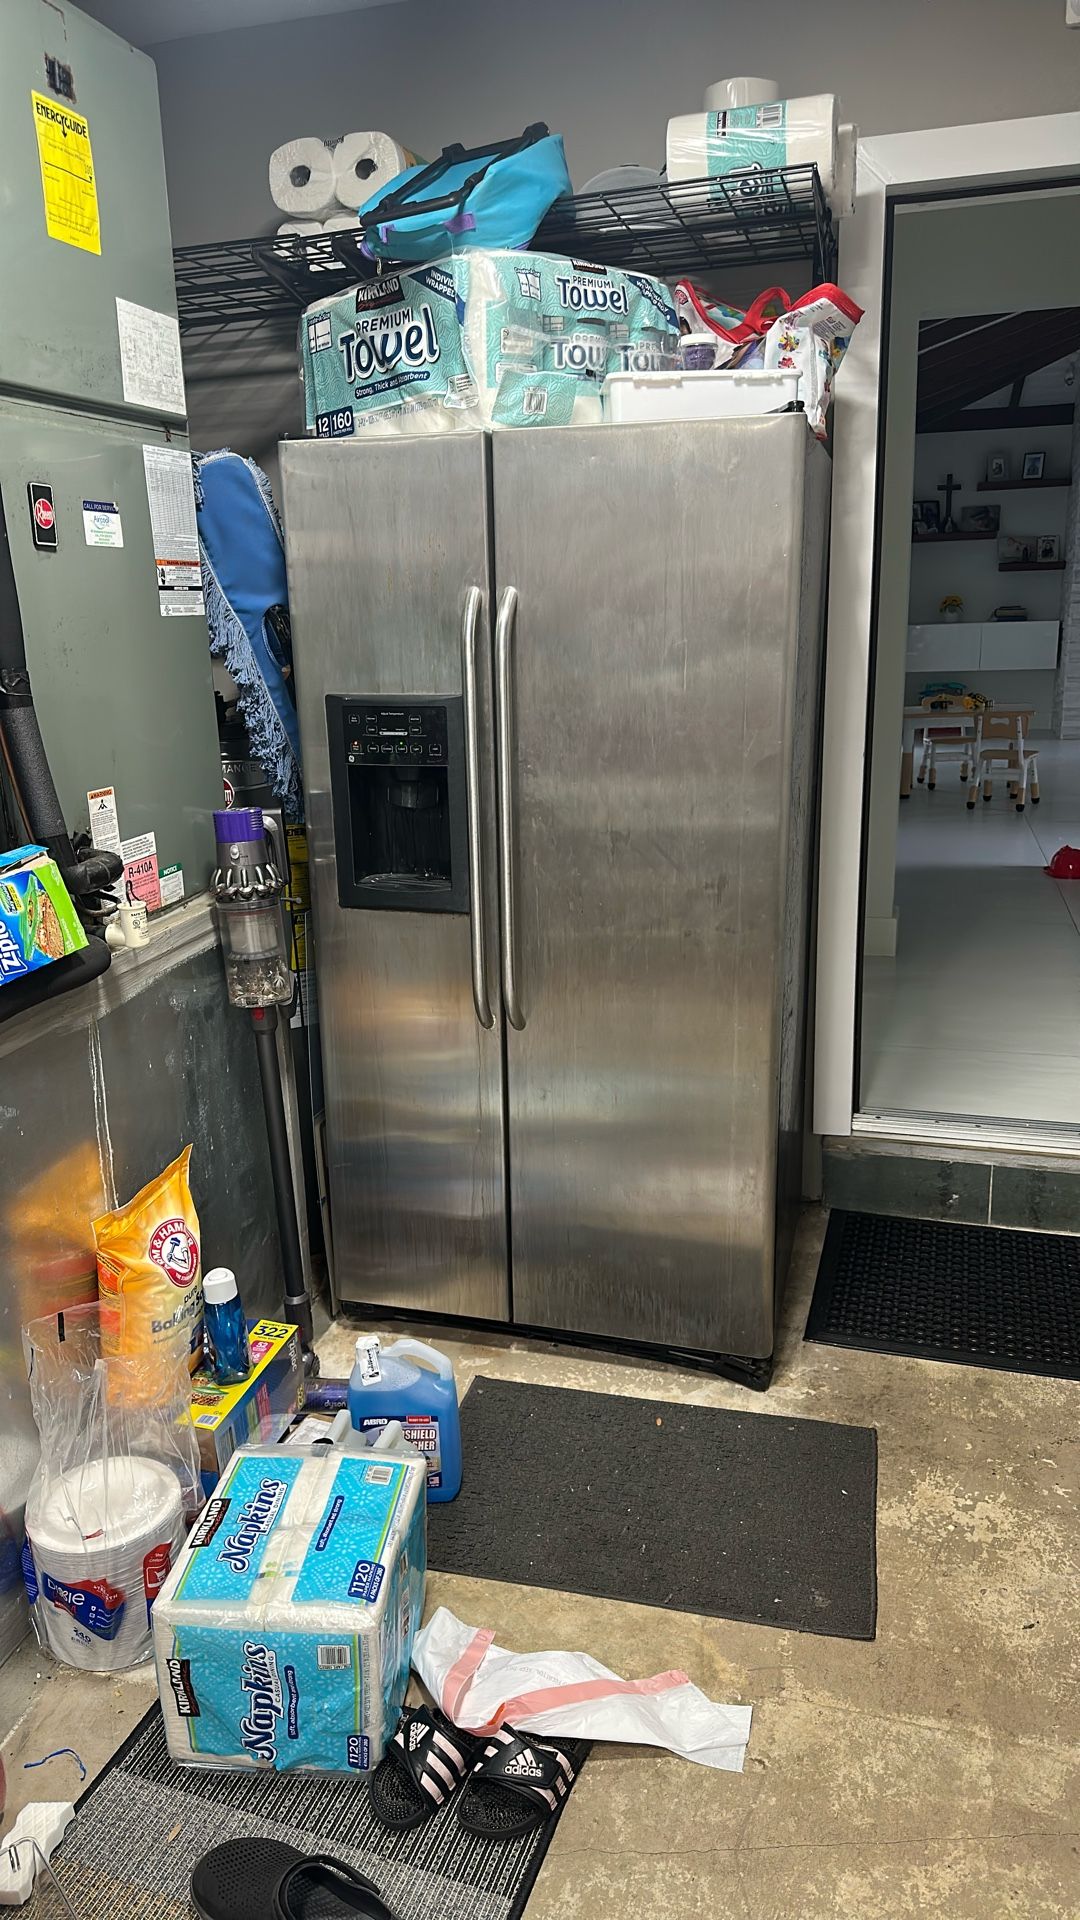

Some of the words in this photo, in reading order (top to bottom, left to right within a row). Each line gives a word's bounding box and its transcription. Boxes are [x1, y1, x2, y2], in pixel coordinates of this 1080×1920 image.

[36, 101, 88, 138] ENERGYGUIDE
[573, 275, 612, 289] PREMIUM
[557, 277, 628, 315] Towel
[356, 309, 413, 333] PREMIUM
[339, 306, 438, 383] Towel
[375, 381, 389, 391] Thick
[318, 417, 329, 433] 12
[333, 411, 352, 430] 160
[94, 789, 112, 799] WARNING
[128, 861, 153, 879] R-410A
[163, 865, 178, 875] NOTICE
[153, 1239, 163, 1249] &
[184, 1285, 198, 1303] pure
[254, 1325, 288, 1338] 322
[324, 1400, 346, 1410] dyson
[363, 1418, 388, 1426] ABRO
[263, 1508, 277, 1534] CASUAL
[274, 1486, 286, 1507] DINING
[191, 1499, 223, 1547] KIRKLAND
[219, 1479, 281, 1571] Napkins
[351, 1563, 370, 1593] 1120
[370, 1582, 379, 1595] PACKS
[268, 1656, 276, 1682] DINING
[170, 1660, 191, 1714] KIRKLAND
[273, 1683, 281, 1703] CASUAL
[241, 1640, 283, 1762] Napkins
[409, 1722, 417, 1752] adidas
[349, 1737, 359, 1763] 1120
[504, 1764, 542, 1777] adidas
